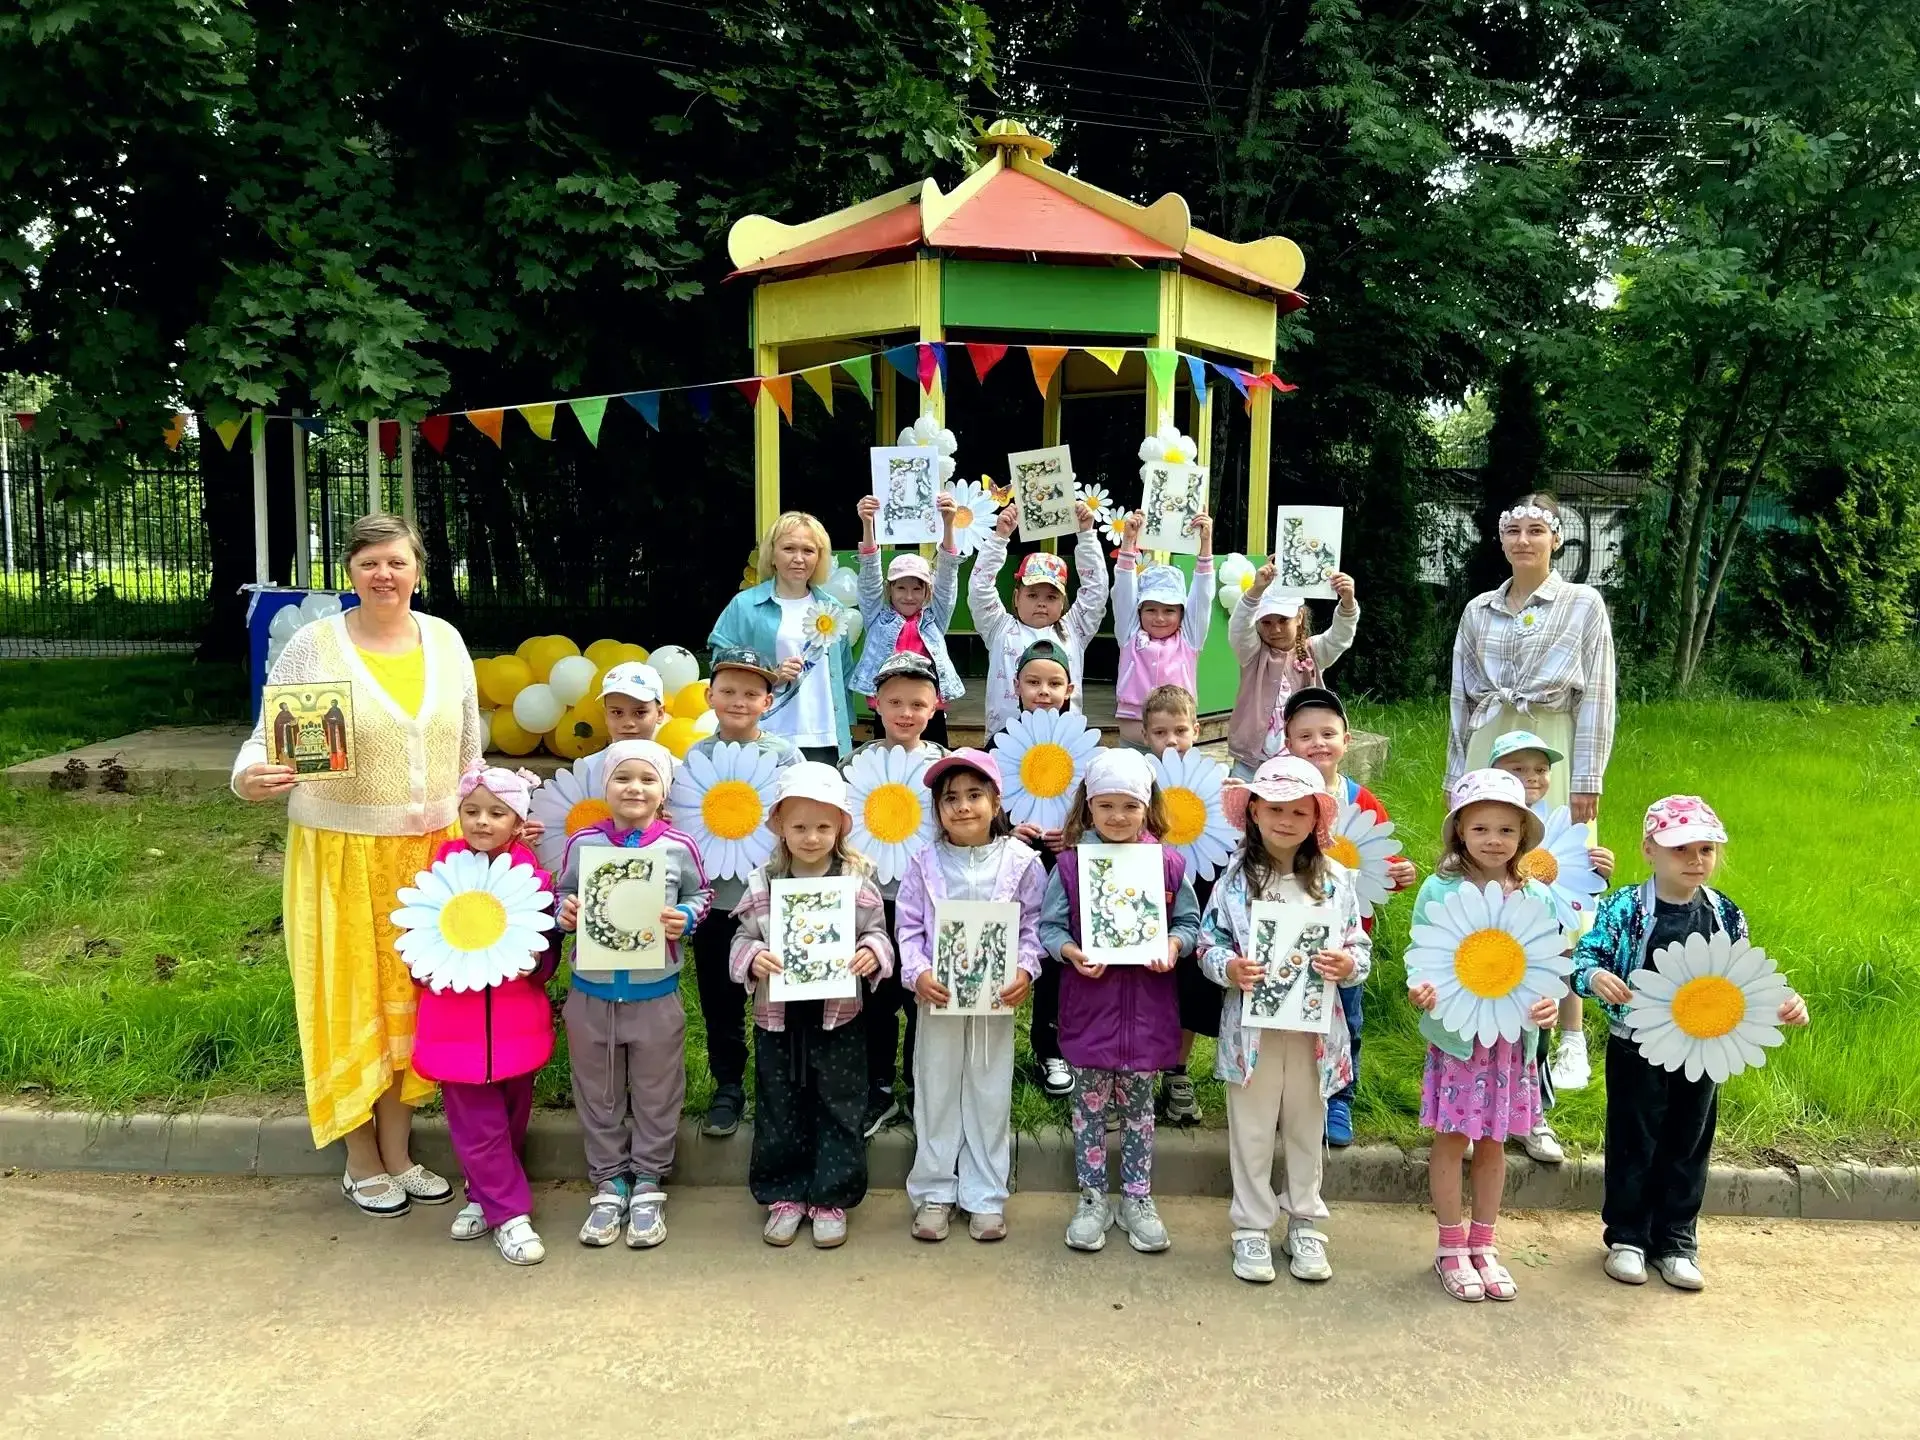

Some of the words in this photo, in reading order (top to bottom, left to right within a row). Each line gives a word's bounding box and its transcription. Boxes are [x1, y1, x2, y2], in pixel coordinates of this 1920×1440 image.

[883, 456, 937, 537] Д
[1015, 456, 1072, 531] Е
[1145, 468, 1204, 540] Н
[1281, 516, 1336, 588] Ь
[585, 858, 658, 952] С
[781, 890, 849, 985] Е
[1088, 858, 1161, 949] Ь
[937, 919, 1008, 1010] М
[1249, 919, 1330, 1022] И
